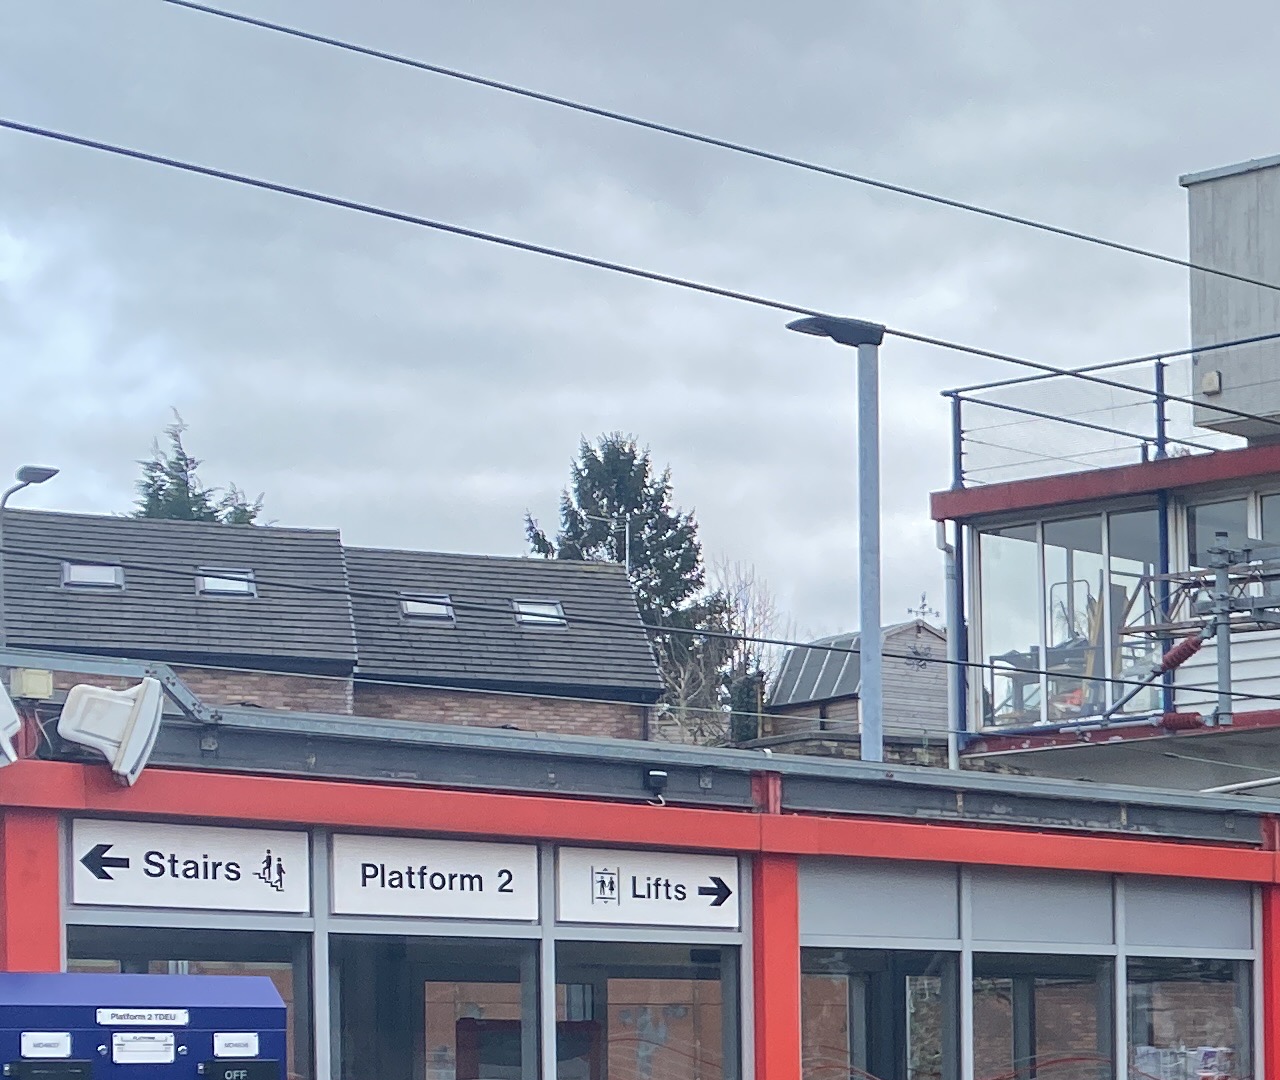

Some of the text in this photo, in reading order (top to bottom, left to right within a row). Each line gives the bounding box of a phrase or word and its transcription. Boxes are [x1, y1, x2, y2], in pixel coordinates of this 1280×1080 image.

[142, 850, 242, 882] Stairs
[360, 864, 515, 894] Platform 2
[630, 875, 688, 901] Lifts
[110, 1012, 146, 1021] Platform
[147, 1013, 153, 1021] 2
[224, 1070, 248, 1080] OFF
